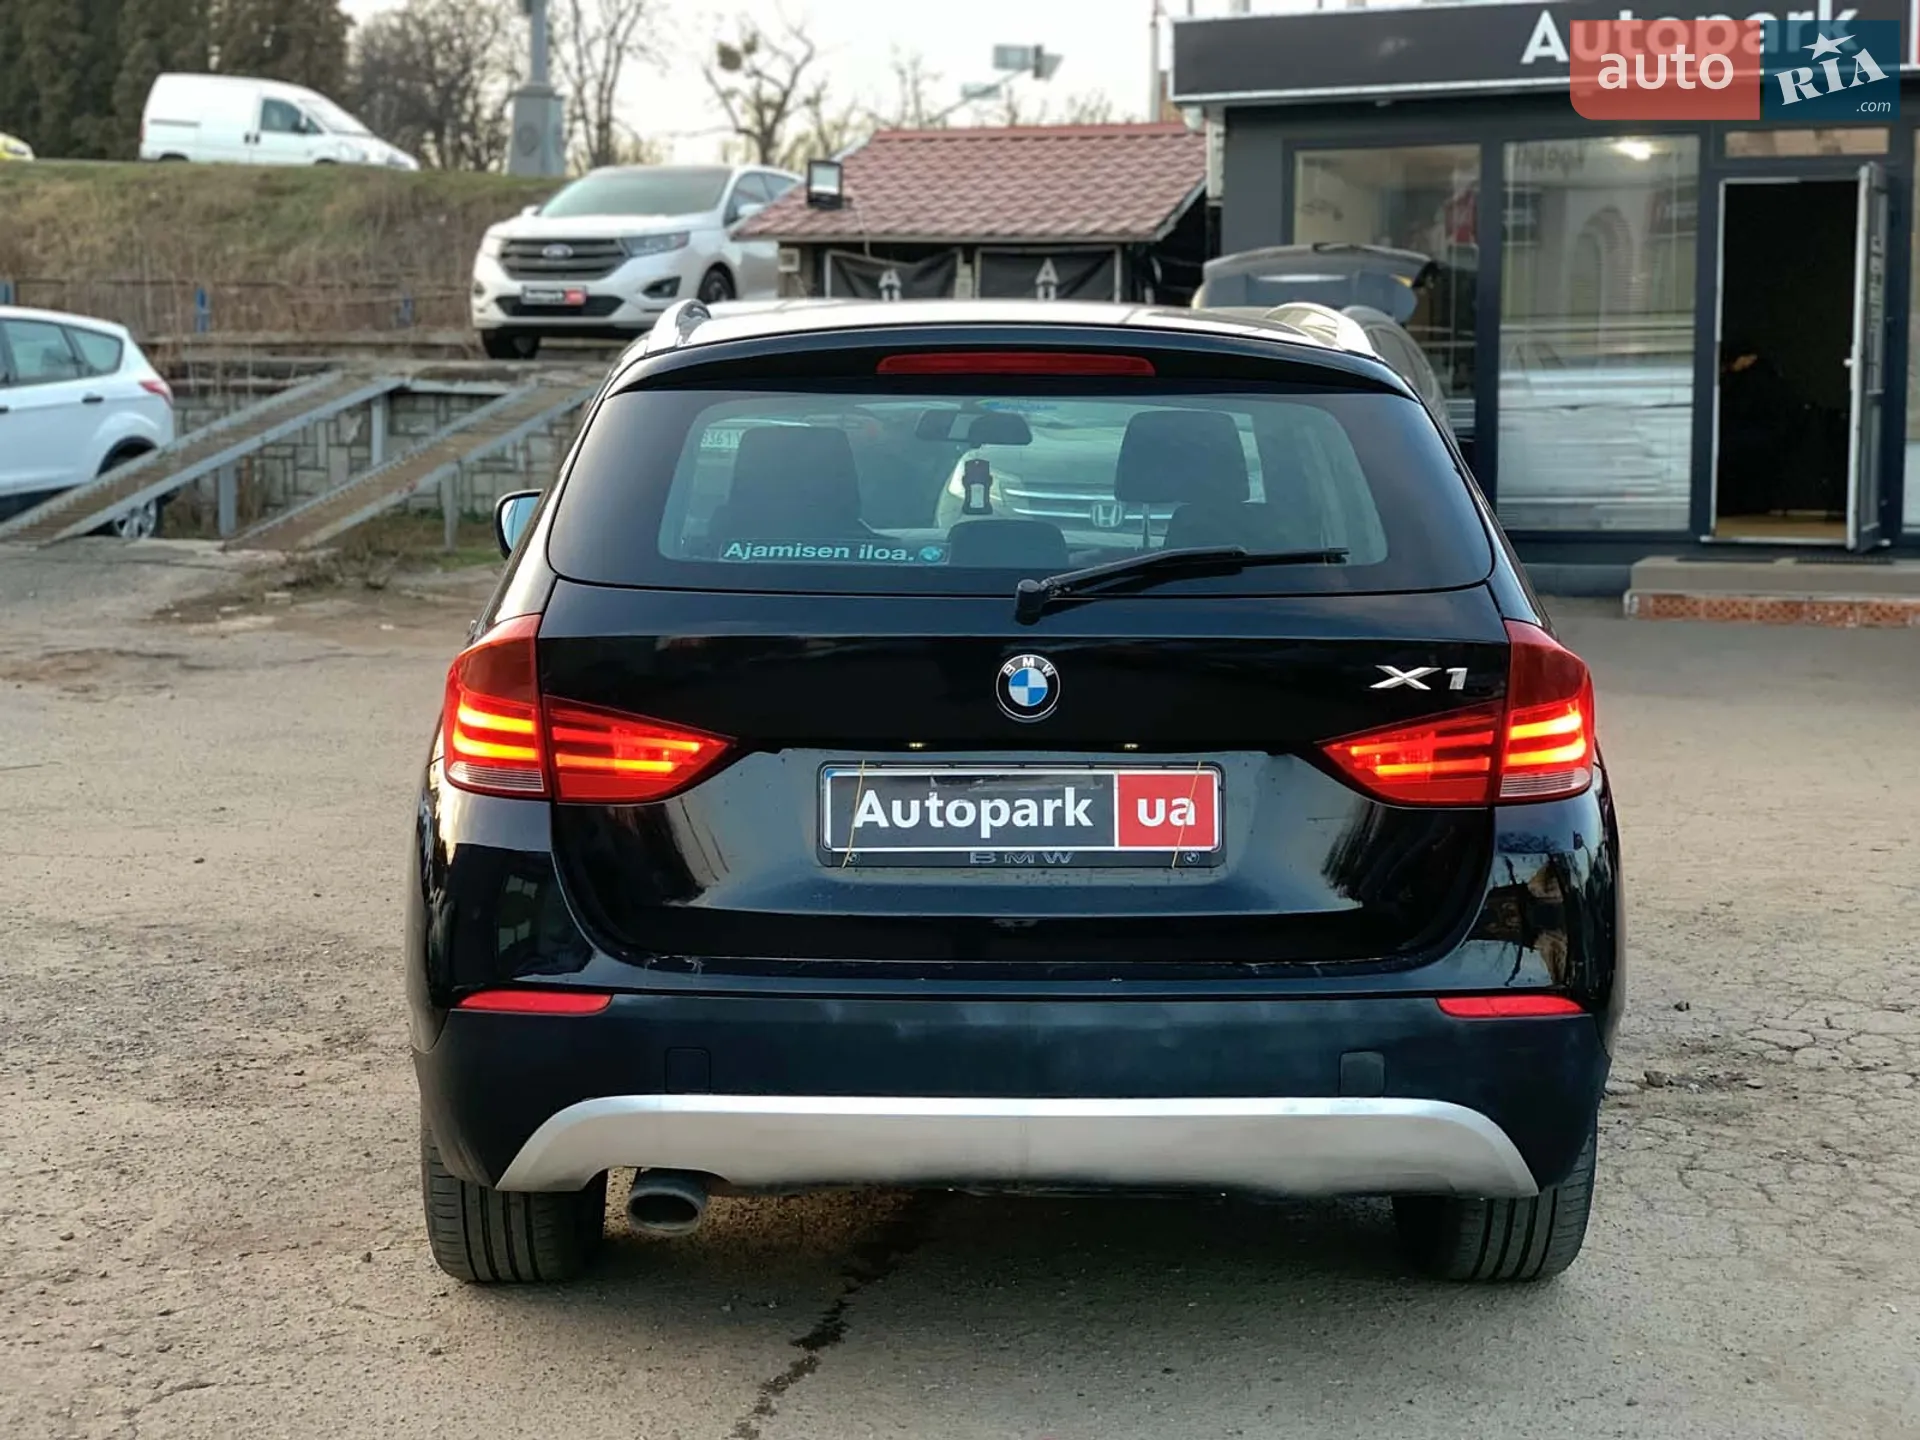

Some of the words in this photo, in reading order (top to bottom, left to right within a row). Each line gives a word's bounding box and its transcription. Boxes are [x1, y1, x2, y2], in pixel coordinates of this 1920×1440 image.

[1520, 0, 1860, 65] Autopark
[723, 542, 849, 560] Ajamisen
[858, 544, 915, 562] iloa.
[1003, 657, 1055, 677] BMW
[1369, 664, 1468, 690] X1
[854, 787, 1095, 839] Autopark
[1137, 797, 1197, 827] ua
[969, 851, 1075, 865] BMW
